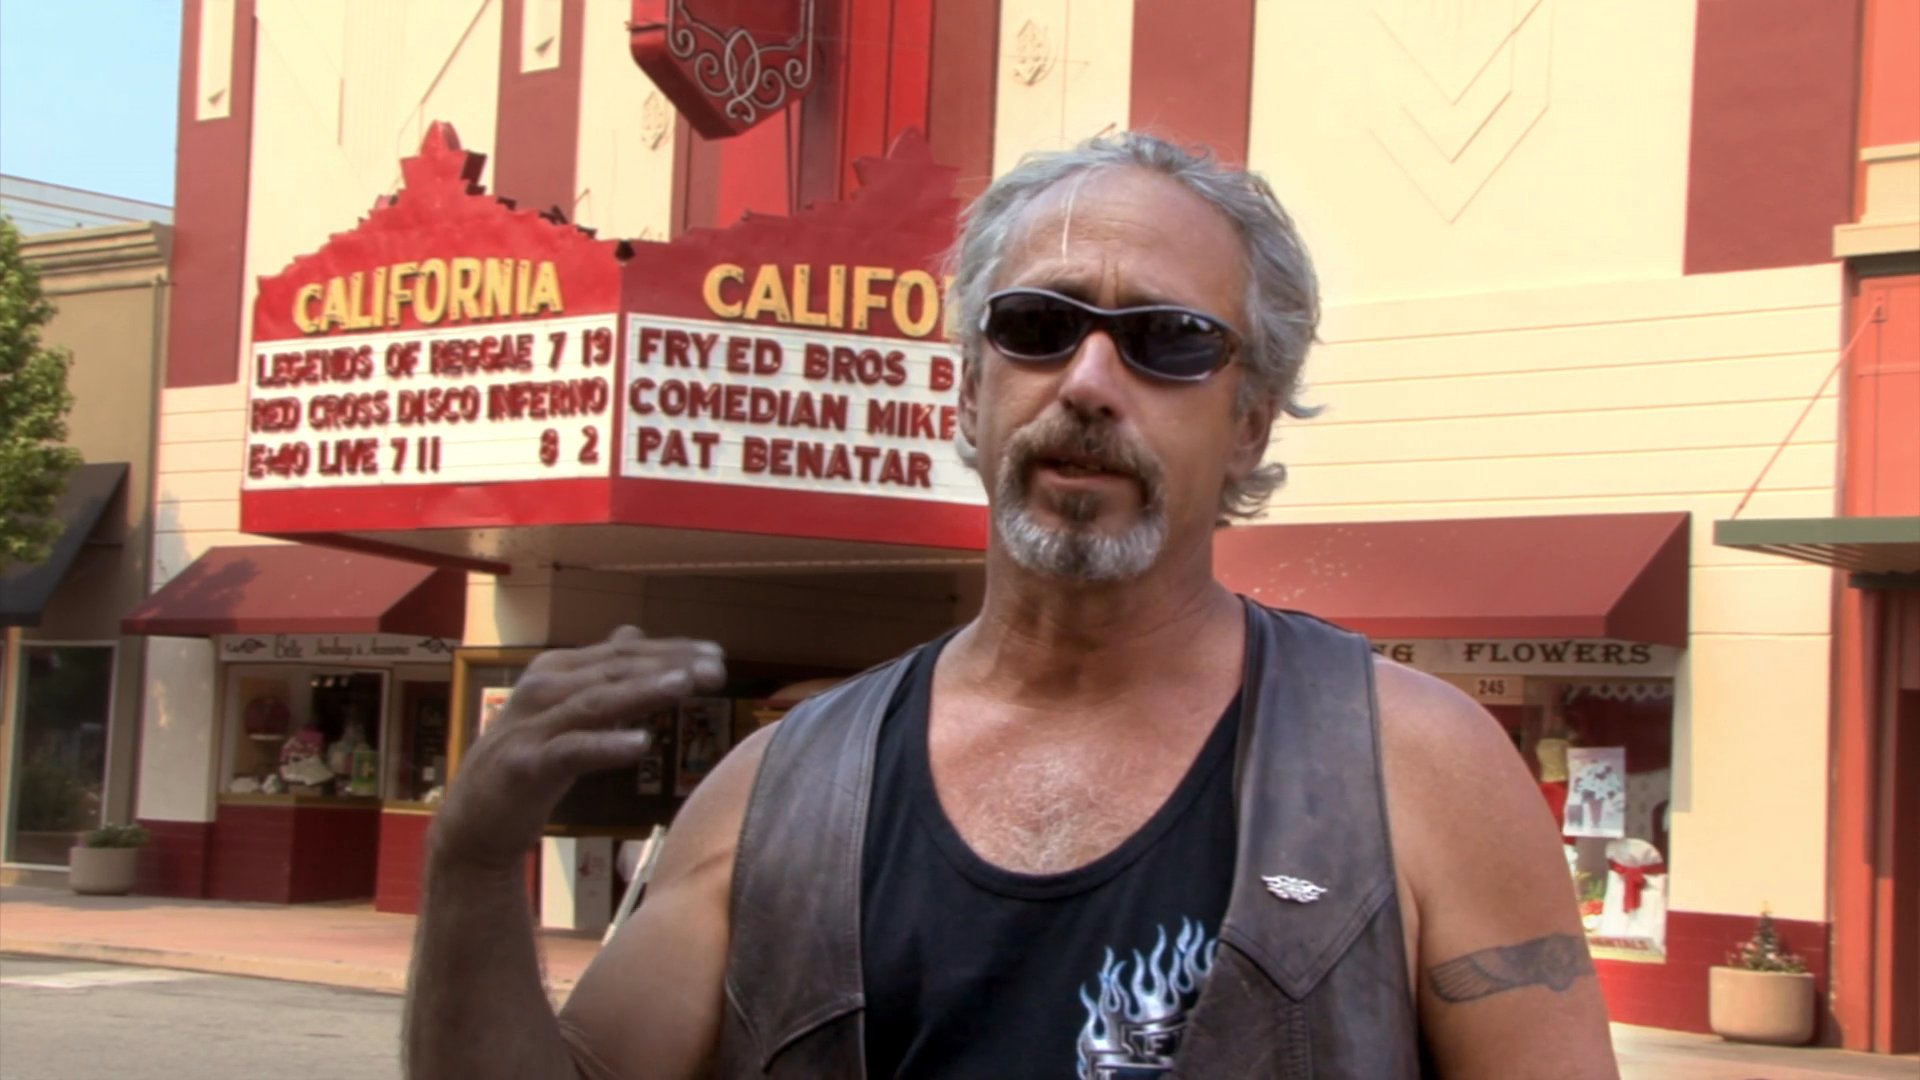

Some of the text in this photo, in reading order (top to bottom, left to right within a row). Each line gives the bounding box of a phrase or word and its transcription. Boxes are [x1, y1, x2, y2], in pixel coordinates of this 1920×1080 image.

[292, 257, 564, 334] CALIFORNIA
[256, 328, 612, 388] LEGENDS OF REGGAE 7 19
[803, 343, 906, 386] BROS
[250, 377, 608, 432] RED CROSS DISCO INFERNO
[629, 377, 957, 440] COMEDIAN MIKE
[317, 437, 379, 476] LIVE
[390, 437, 409, 474] 7
[578, 425, 599, 464] 2
[636, 426, 931, 489] PAT BENATAR
[1463, 642, 1653, 664] FLOWERS
[1478, 679, 1505, 695] 245
